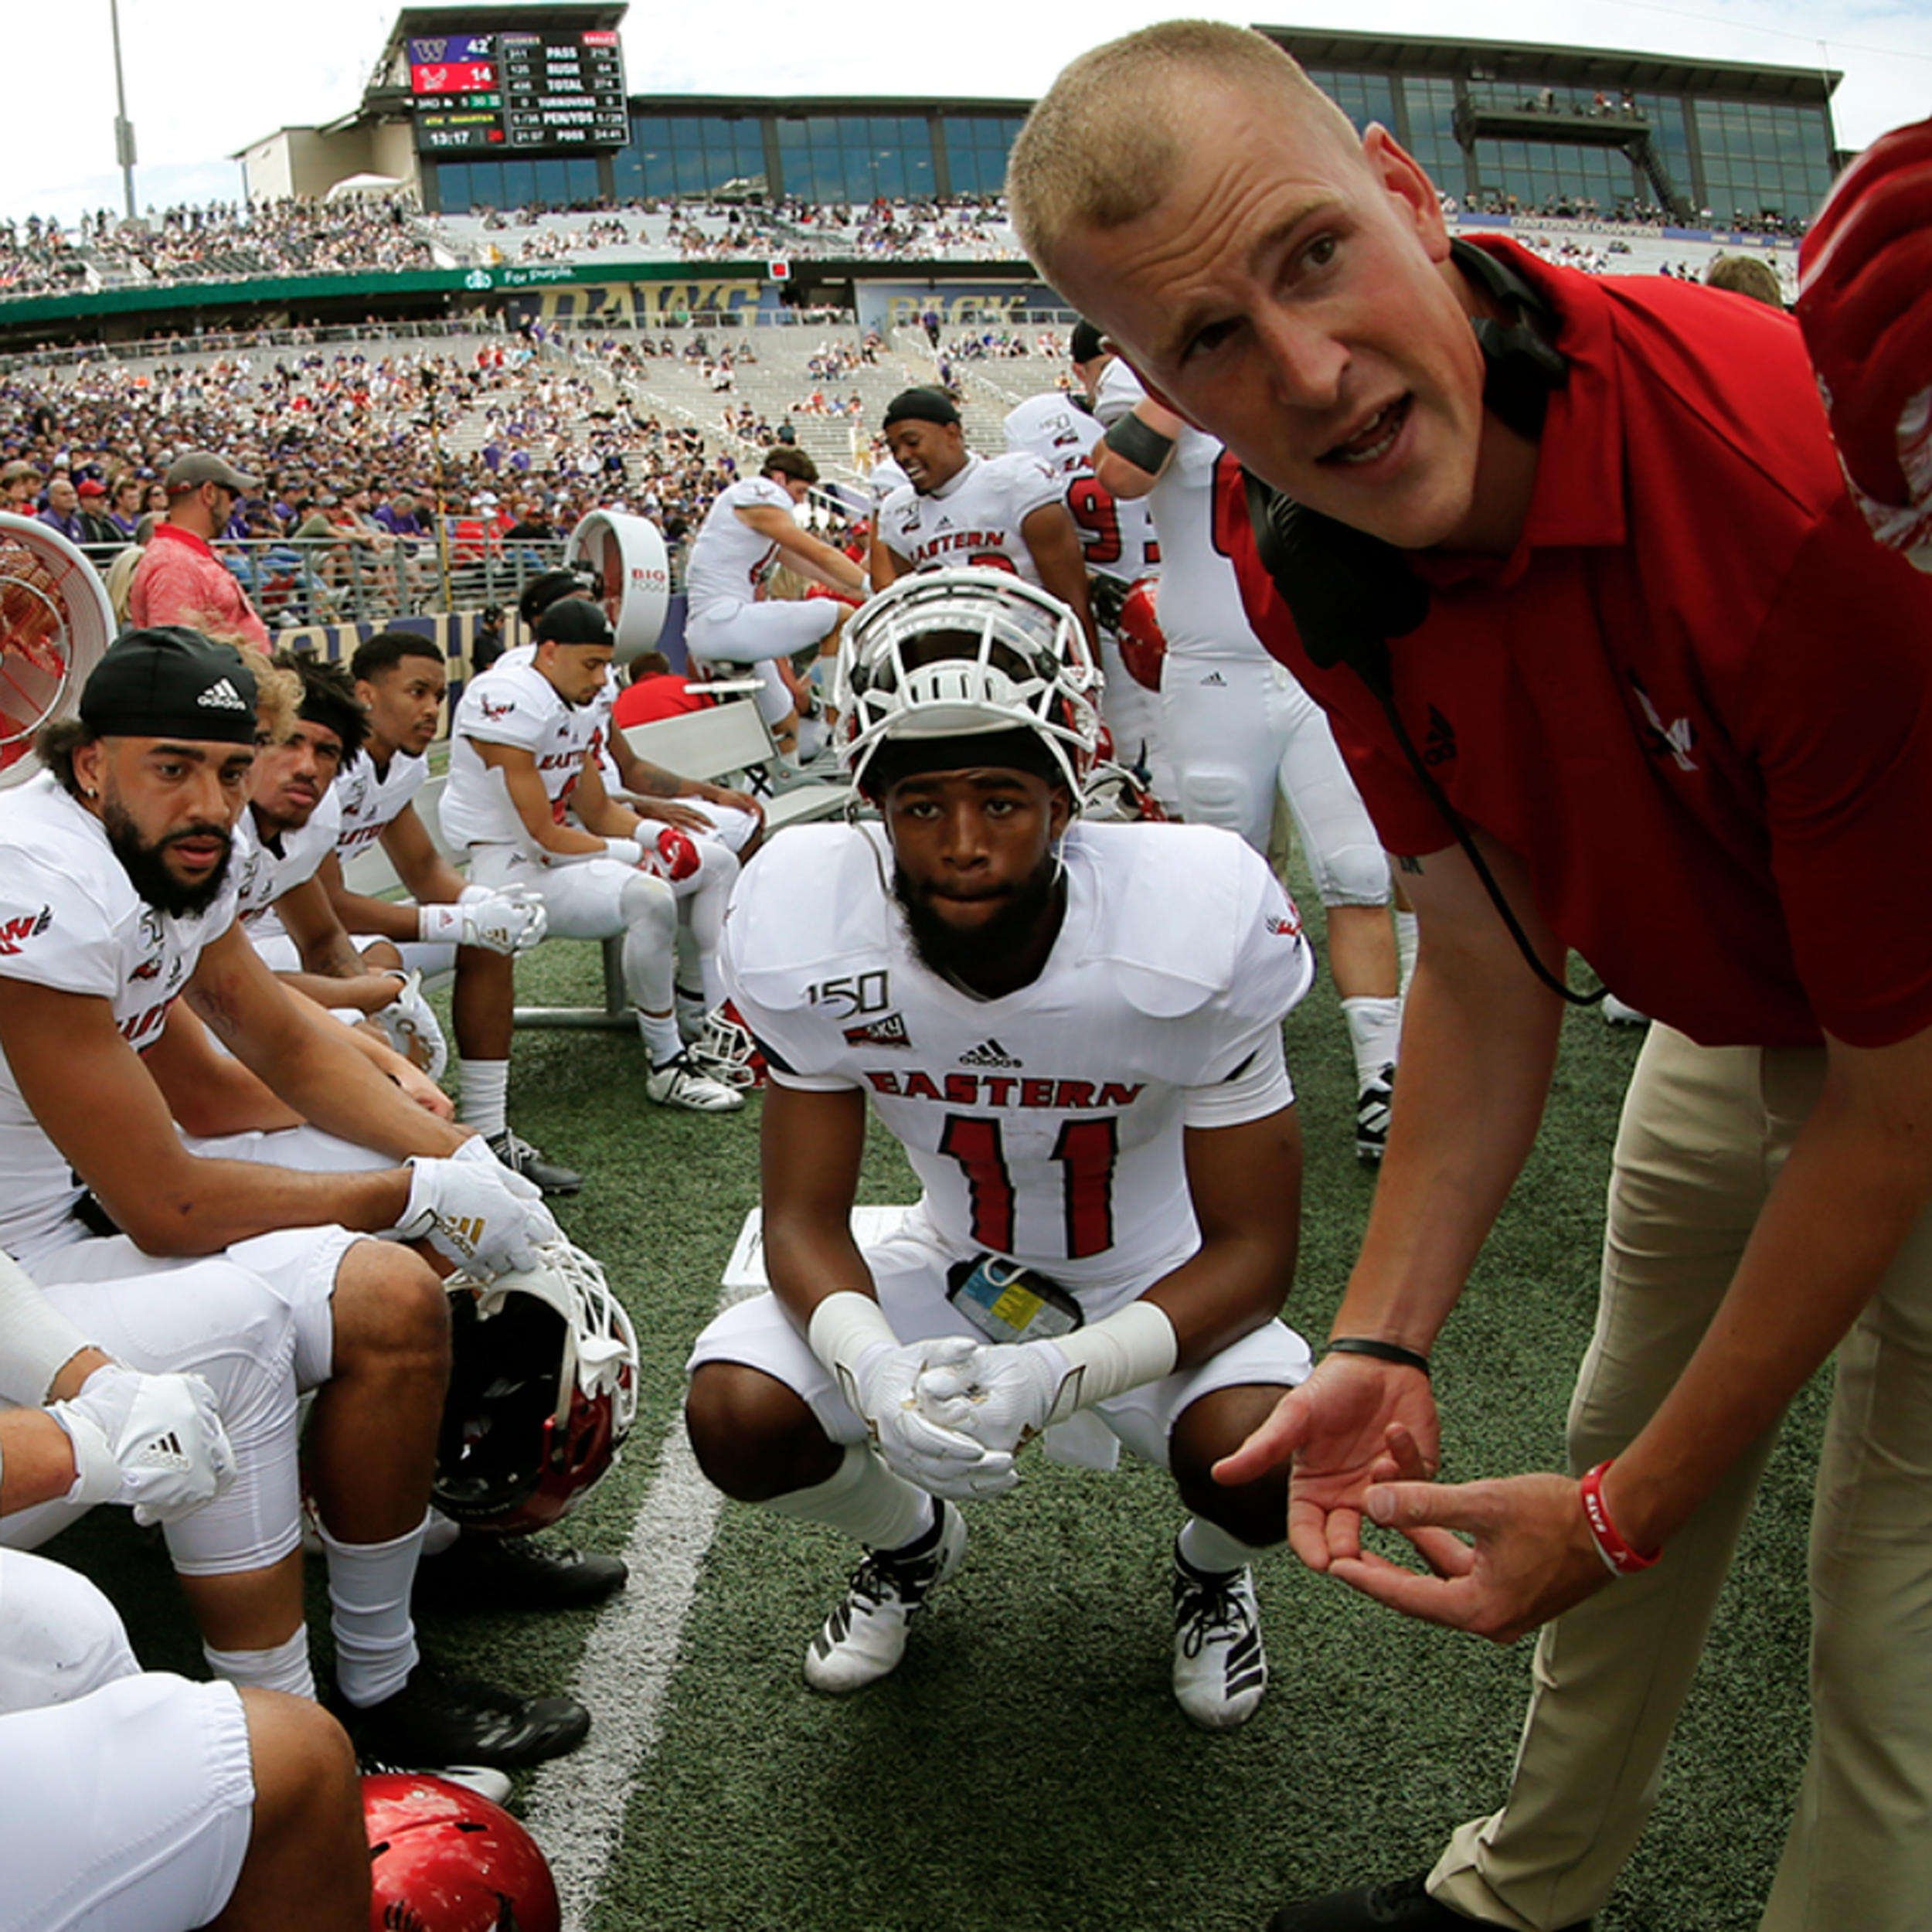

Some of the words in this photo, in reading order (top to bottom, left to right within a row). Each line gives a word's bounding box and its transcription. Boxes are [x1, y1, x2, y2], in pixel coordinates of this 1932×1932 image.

[466, 39, 489, 55] 42
[546, 46, 578, 60] PASS
[471, 66, 492, 81] 14
[546, 78, 583, 92] TOTAL
[504, 269, 528, 284] For
[540, 281, 761, 328] DAWG
[631, 567, 666, 583] BIG
[198, 696, 247, 711] adidas
[804, 969, 889, 1020] 150
[958, 1055, 1022, 1069] adidas
[862, 1070, 1148, 1108] EASTERN
[937, 1112, 1119, 1260] 11
